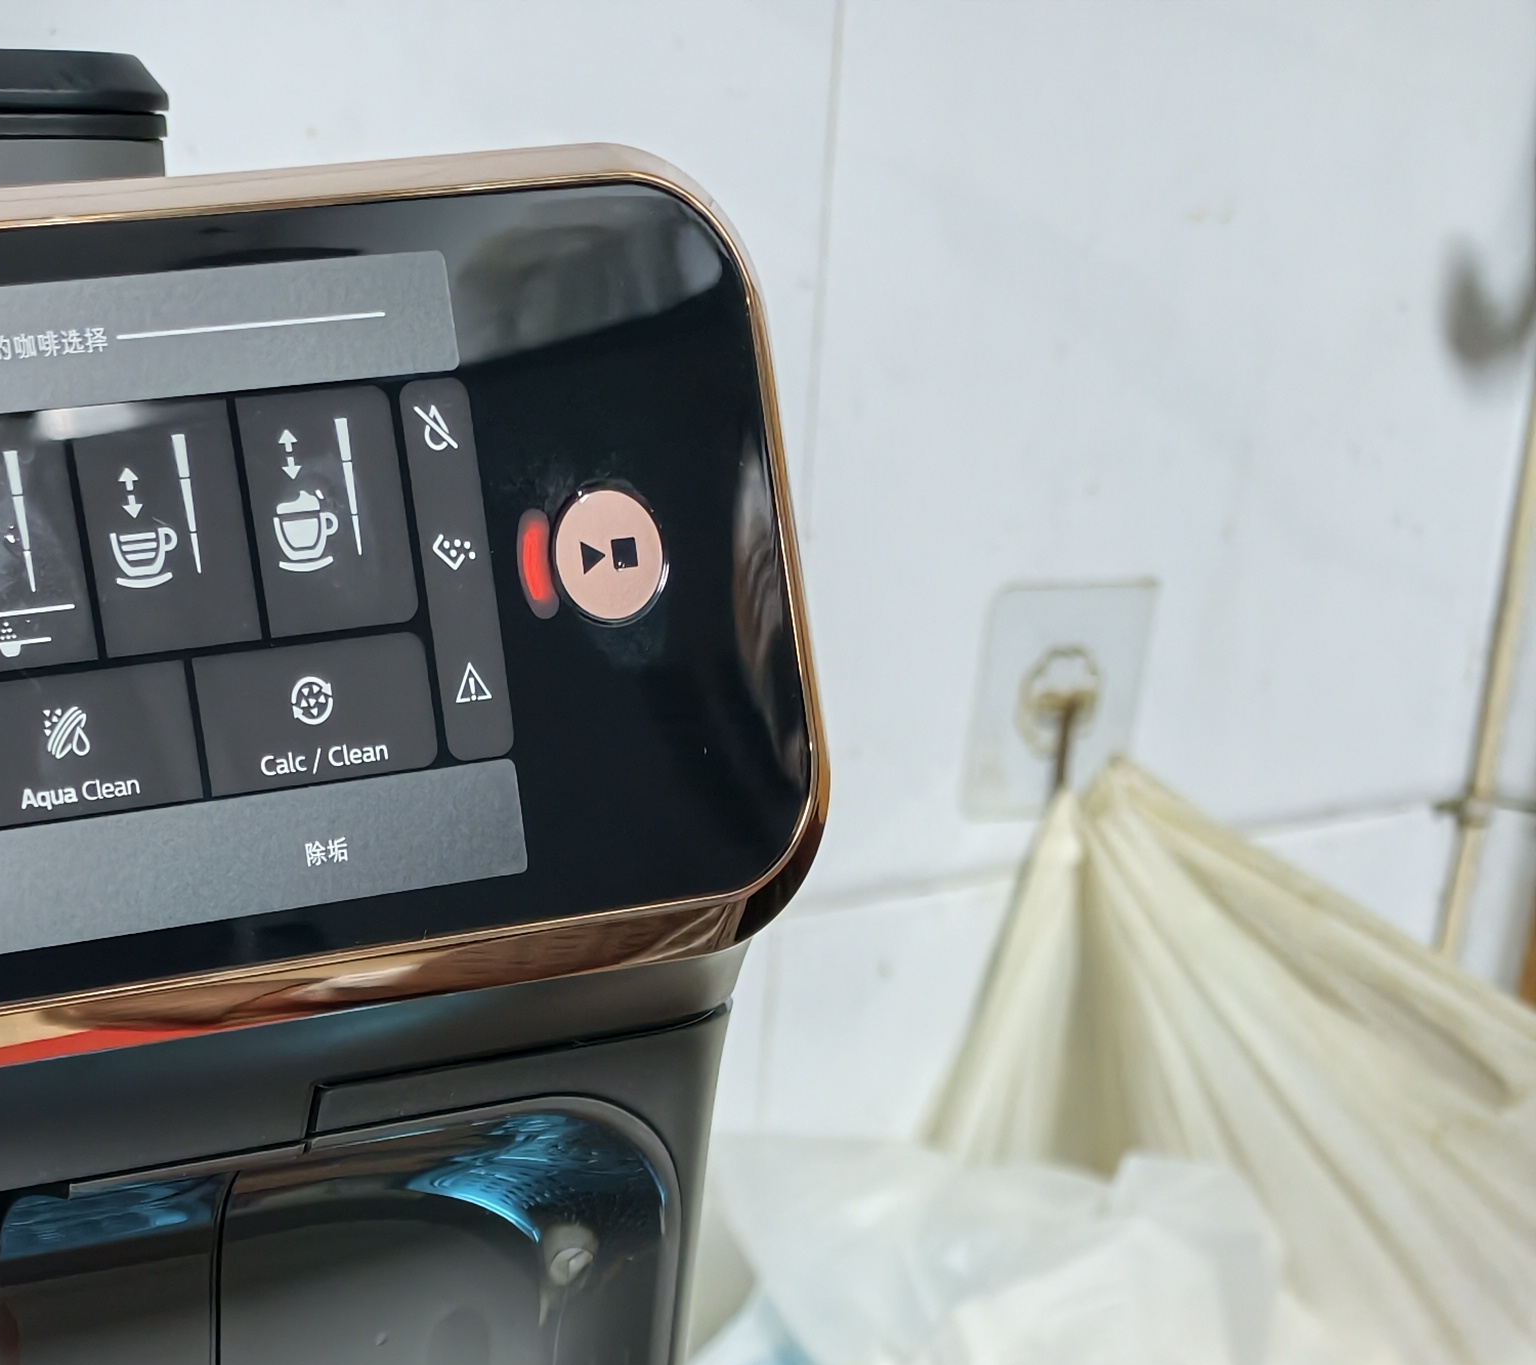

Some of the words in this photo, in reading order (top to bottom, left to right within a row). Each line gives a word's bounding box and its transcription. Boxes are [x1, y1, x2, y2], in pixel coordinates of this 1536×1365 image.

[260, 751, 308, 776] Calc
[328, 743, 389, 767] Clean
[21, 787, 79, 811] Aqua
[81, 779, 141, 801] Clean
[304, 836, 349, 867] 除垢
